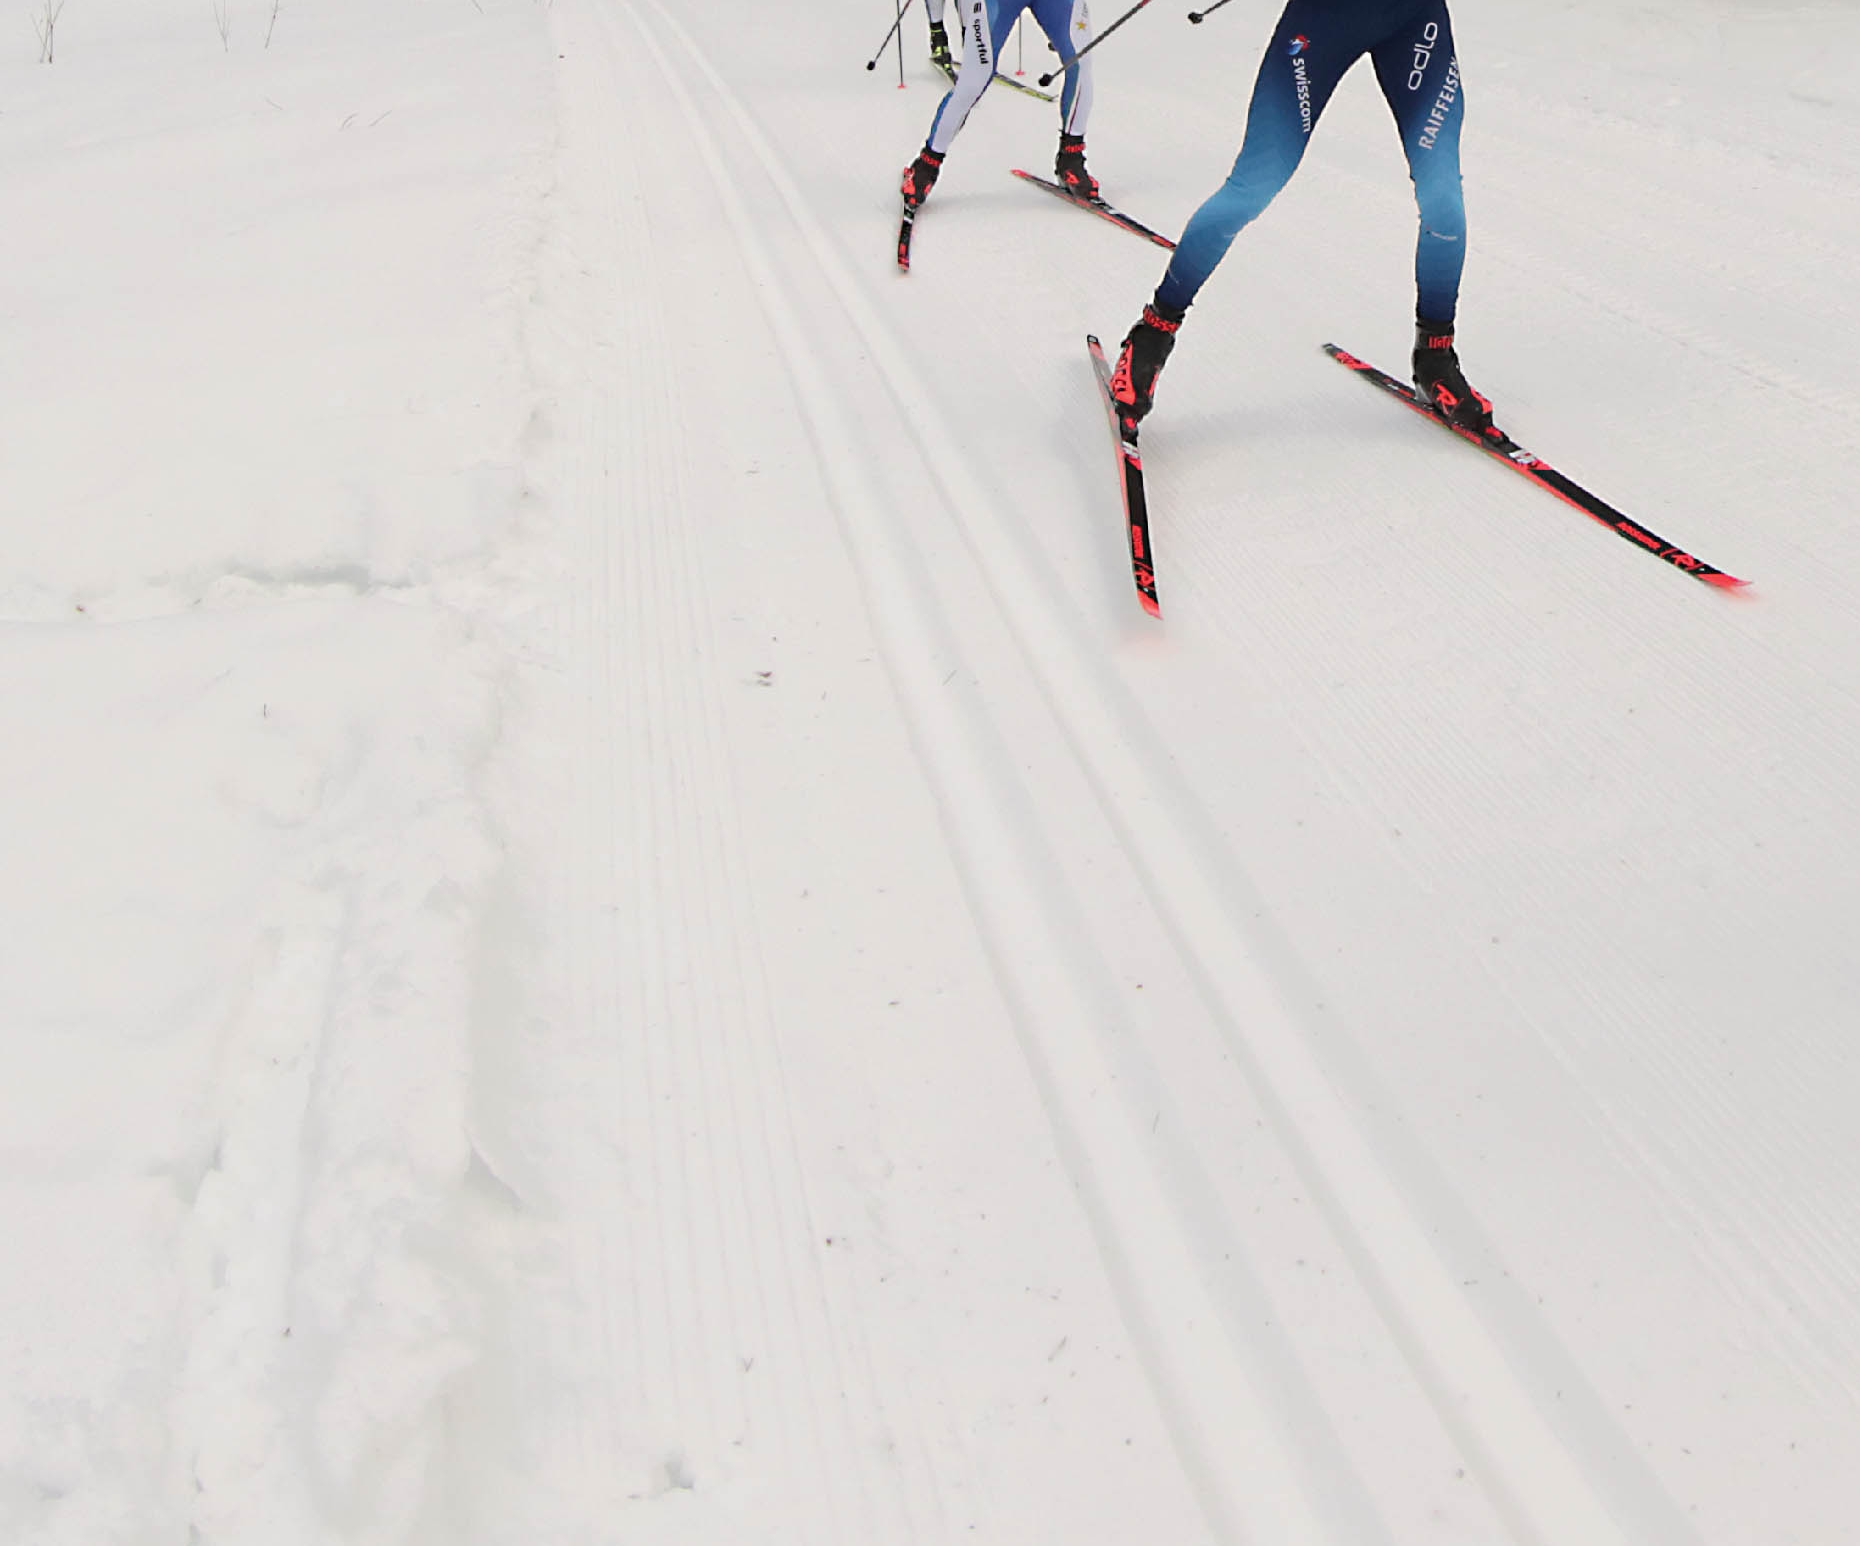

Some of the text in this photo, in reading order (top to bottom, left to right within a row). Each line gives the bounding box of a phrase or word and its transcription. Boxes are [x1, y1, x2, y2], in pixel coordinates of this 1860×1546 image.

[972, 18, 989, 65] sportful
[1407, 22, 1438, 91] odlo
[1292, 57, 1313, 133] swisscom
[1418, 56, 1461, 151] RAIFFEISEN
